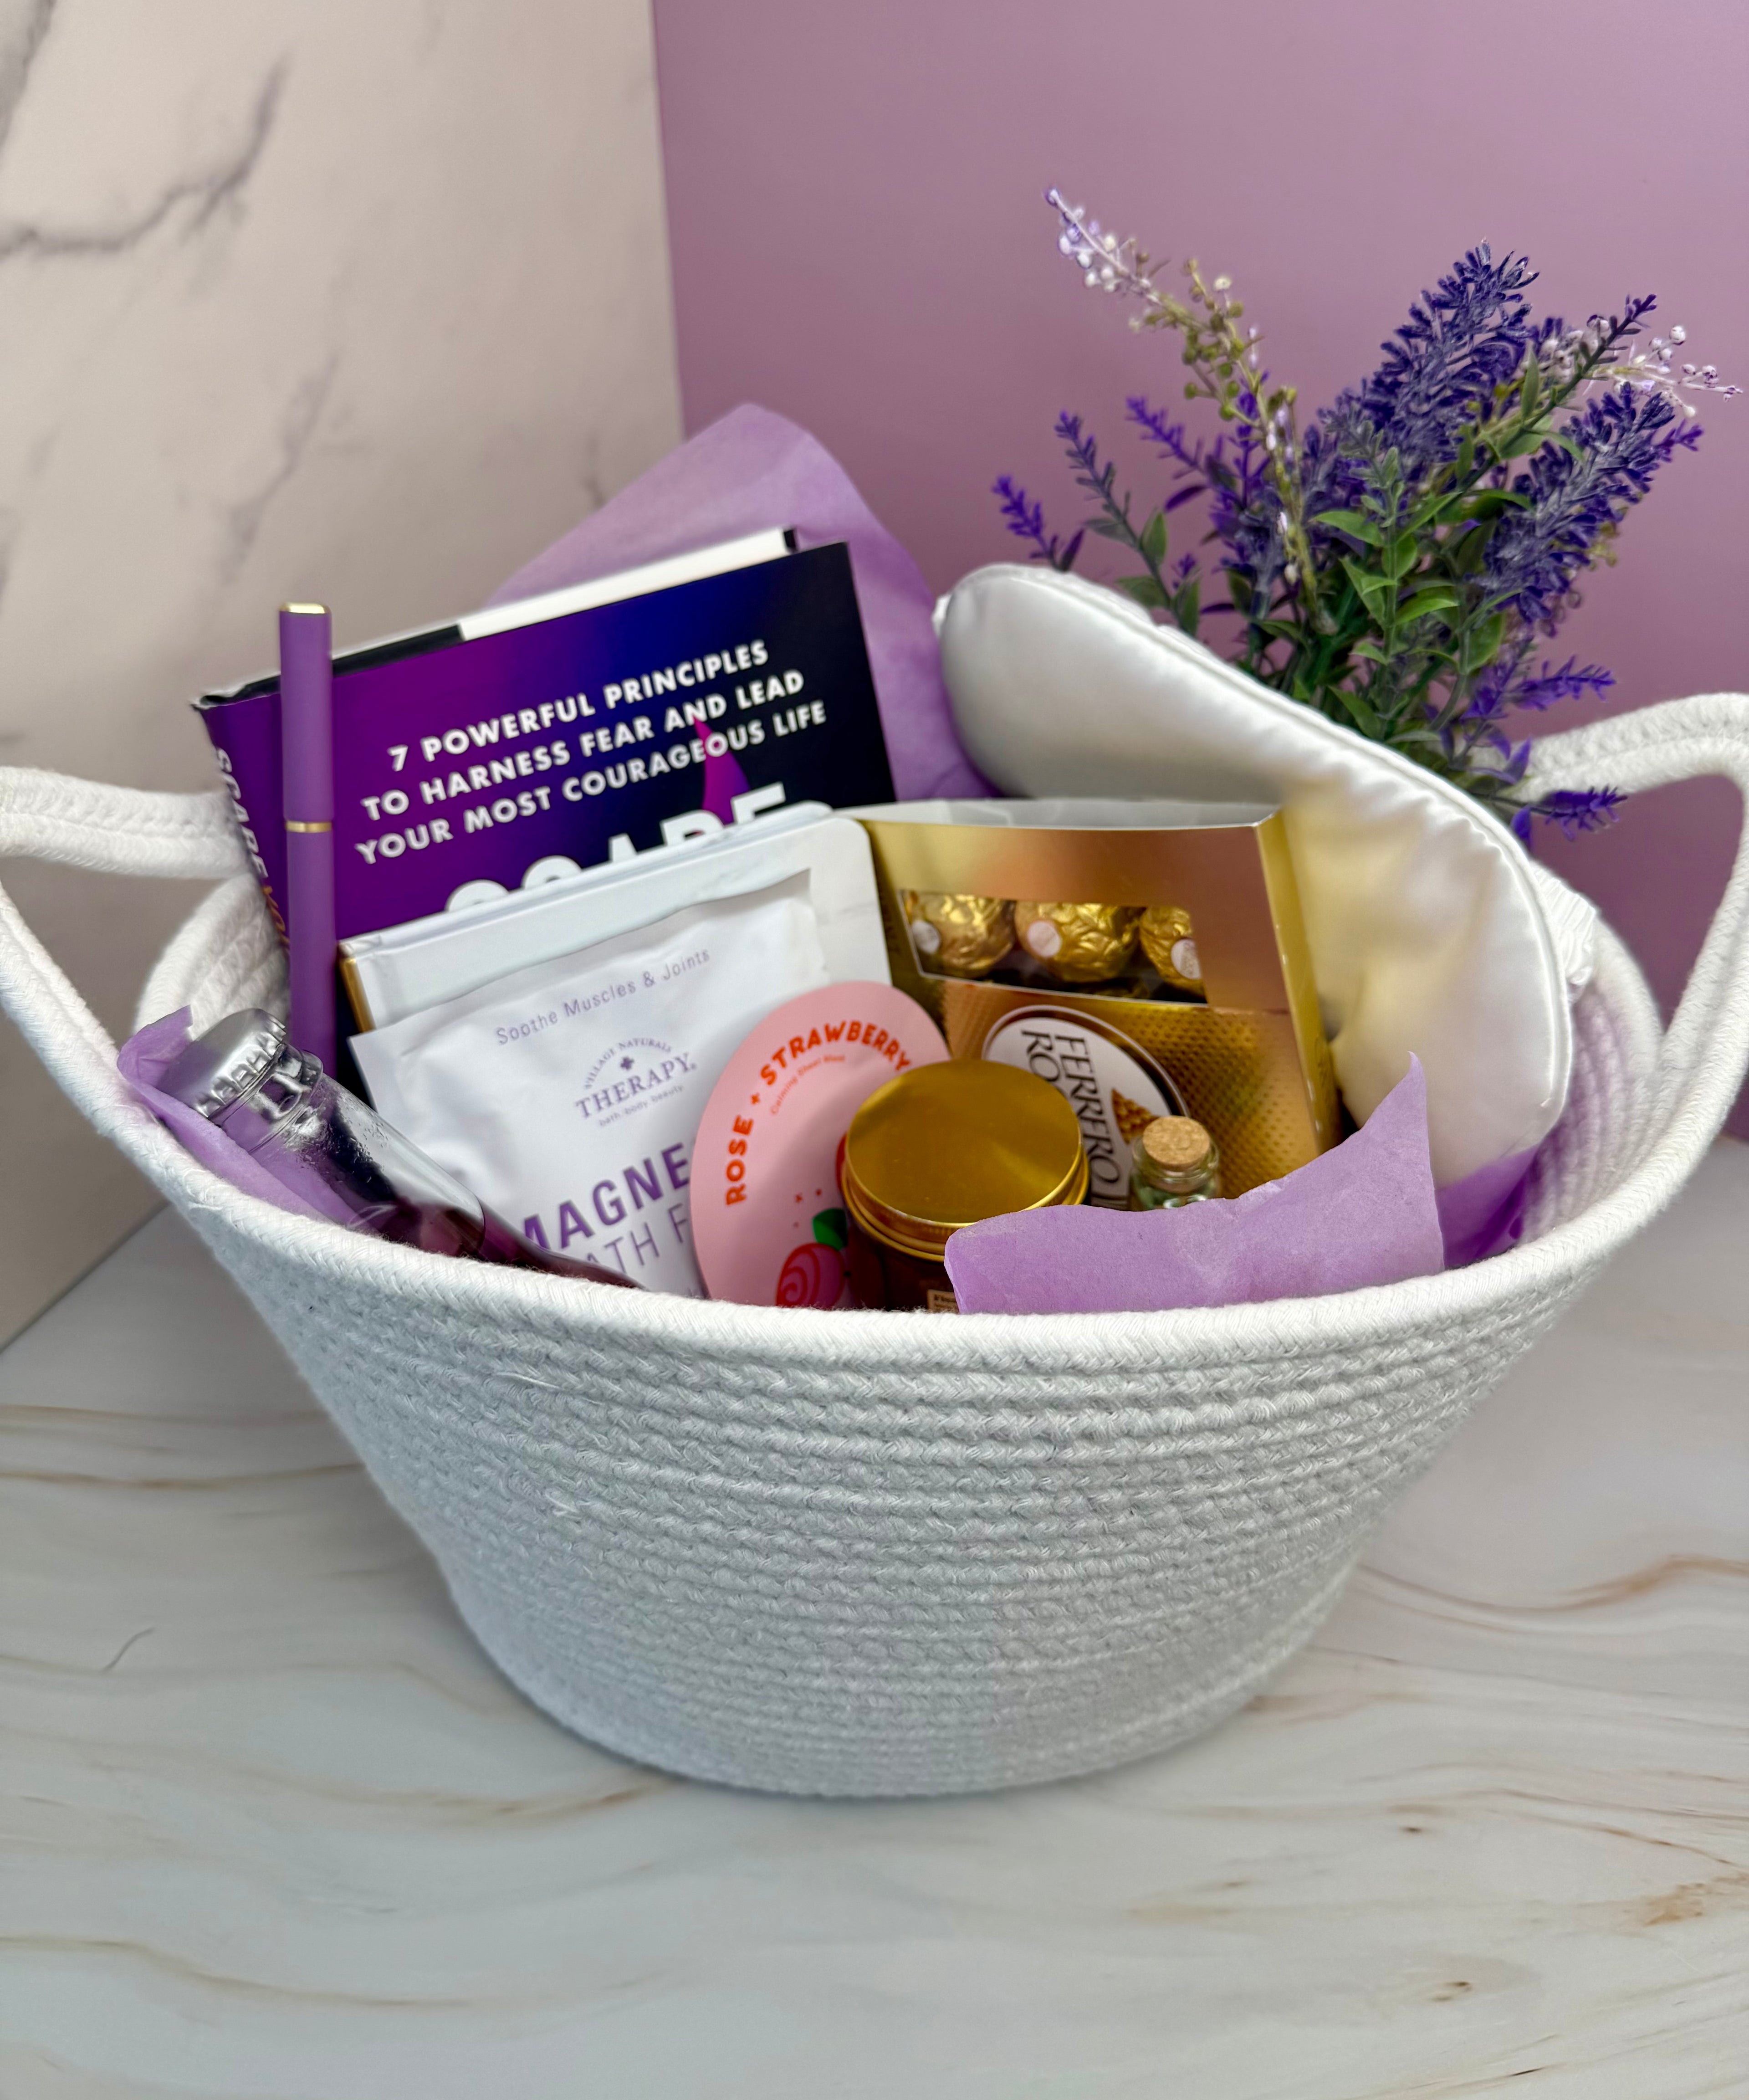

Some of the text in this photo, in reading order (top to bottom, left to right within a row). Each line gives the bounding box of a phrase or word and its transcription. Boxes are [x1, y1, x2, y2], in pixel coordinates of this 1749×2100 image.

[361, 669, 804, 820] TO HARNESS FEAR AND LEAD
[387, 639, 768, 771] 7 POWERFUL PRINCIPLES
[354, 700, 826, 864] YOUR MOST COURAGEOUS LIFE
[496, 949, 711, 1045] Soothe Muscles & Joints
[585, 1037, 671, 1088] VILLAGE NATURALS
[726, 1115, 754, 1206] ROSE
[760, 1021, 910, 1086] STRAWBERRY
[1055, 1034, 1120, 1183] FERRERO
